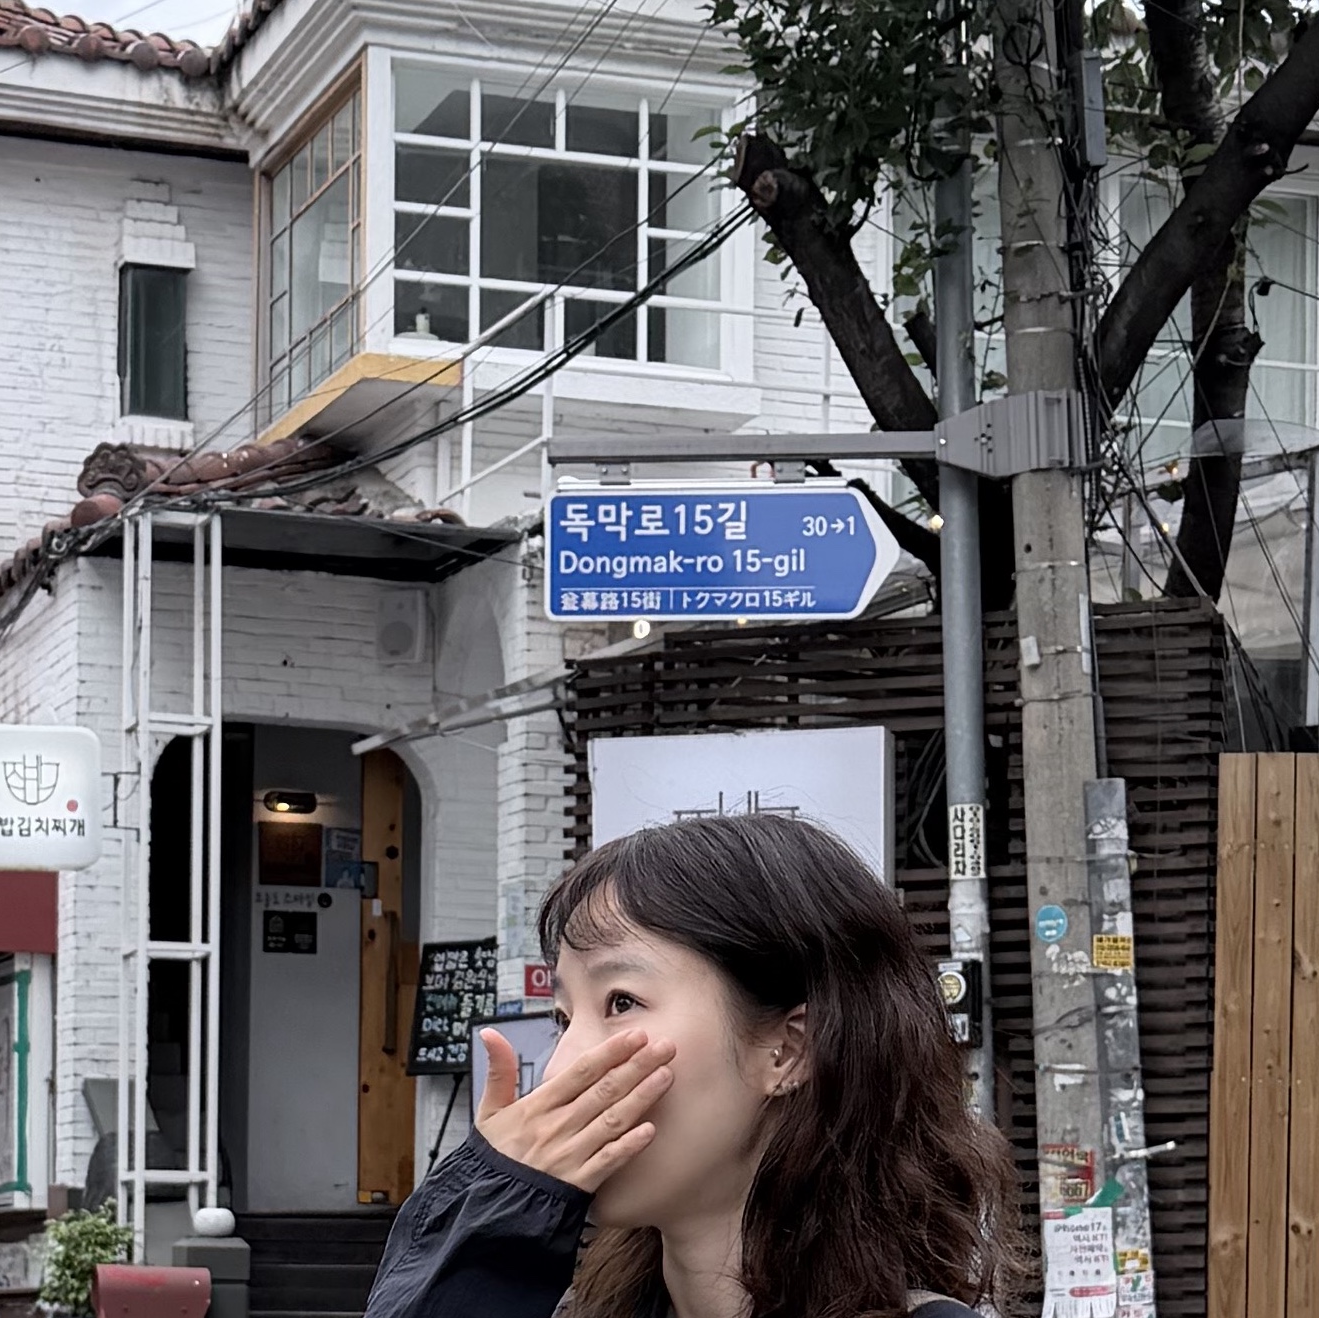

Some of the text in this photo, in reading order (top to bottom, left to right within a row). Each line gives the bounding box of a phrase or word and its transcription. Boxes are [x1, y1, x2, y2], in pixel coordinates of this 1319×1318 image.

[559, 500, 747, 542] 독막로15길
[559, 548, 805, 578] Dongmak-ro 15-gil
[682, 590, 816, 610] トクマクロ15ギル
